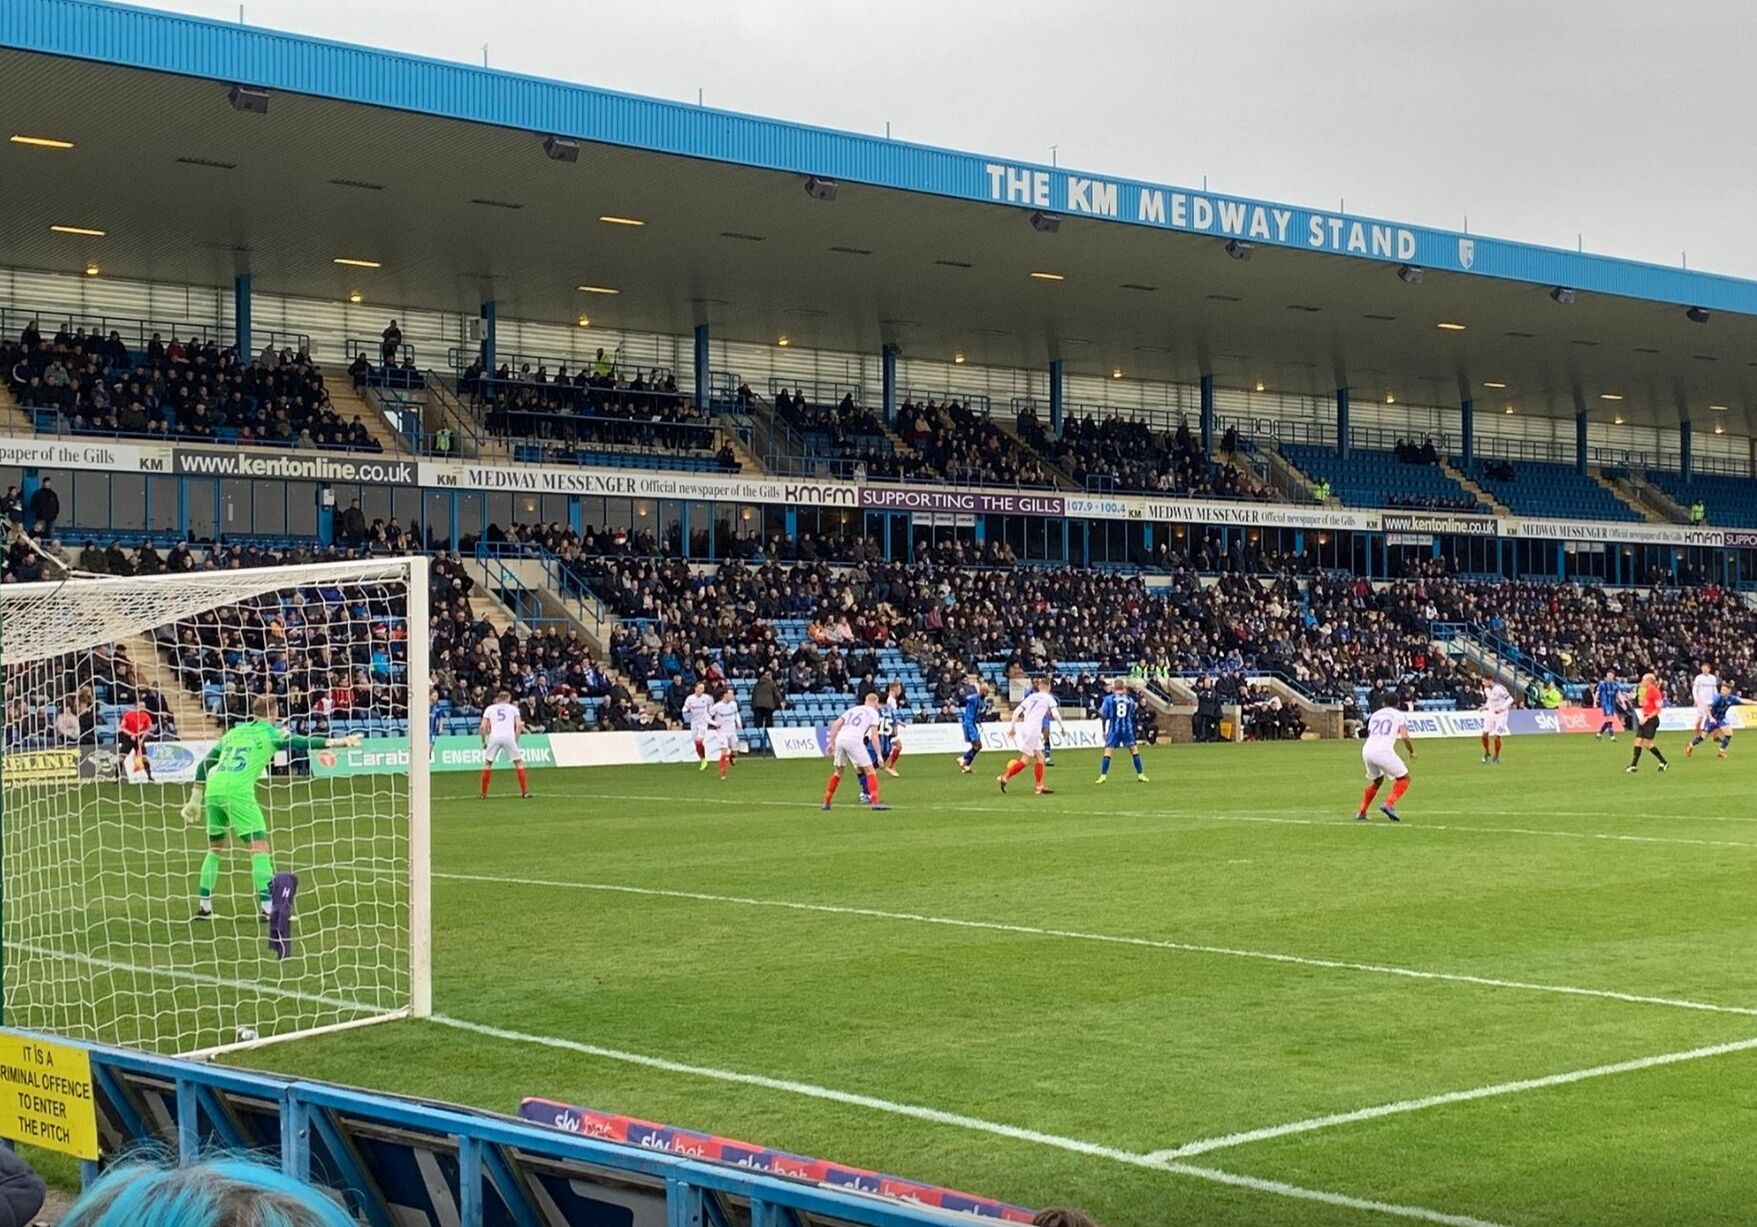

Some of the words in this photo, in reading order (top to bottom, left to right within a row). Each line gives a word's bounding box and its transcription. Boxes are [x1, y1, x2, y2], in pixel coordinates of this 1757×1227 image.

[986, 163, 1050, 207] THE
[1067, 176, 1118, 217] KM
[1138, 189, 1292, 242] MEDWAY
[1308, 214, 1417, 261] STAND
[41, 446, 55, 461] of
[59, 448, 80, 463] the
[83, 448, 115, 464] Gills
[139, 458, 163, 471] KM
[181, 453, 411, 483] www.kentonline.co.uk
[437, 474, 457, 486] KM
[468, 469, 538, 489] MEDWAY
[542, 473, 636, 493] MESSENGER
[640, 479, 676, 494] Official
[679, 482, 729, 498] newspaper
[731, 483, 742, 497] of
[742, 484, 758, 498] the
[759, 484, 780, 499] Gills
[863, 489, 974, 509] SUPPORTING
[981, 496, 1013, 511] THE
[1019, 498, 1061, 513] GILLS
[1066, 500, 1093, 512] 107.9
[1100, 501, 1126, 513] 100.4
[1128, 509, 1142, 518] KM
[1149, 504, 1194, 519] MEDWAY
[1197, 506, 1259, 523] MESSENGER
[1261, 510, 1286, 522] Official
[1366, 520, 1378, 529] KM
[1384, 516, 1496, 535] www.kentonline.co.uk
[1522, 522, 1557, 537] MEDWAY
[1560, 524, 1608, 538] MESSENGER
[1029, 700, 1039, 712] 7
[1116, 702, 1127, 718] 8
[497, 708, 506, 722] 5
[845, 712, 862, 727] 16
[1535, 710, 1561, 732] sky
[1561, 713, 1592, 728] bet
[878, 716, 894, 736] 15
[1371, 719, 1393, 736] 20
[1405, 719, 1438, 732] EMS
[784, 738, 815, 751] KIMS
[507, 748, 551, 763] RINK
[23, 1045, 32, 1062] IT
[34, 1044, 44, 1065] IS
[46, 1050, 54, 1067] A
[42, 1073, 91, 1099] OFFENCE
[18, 1091, 32, 1110] TO
[33, 1095, 66, 1119] ENTER
[18, 1115, 38, 1136] THE
[40, 1121, 70, 1144] PITCH
